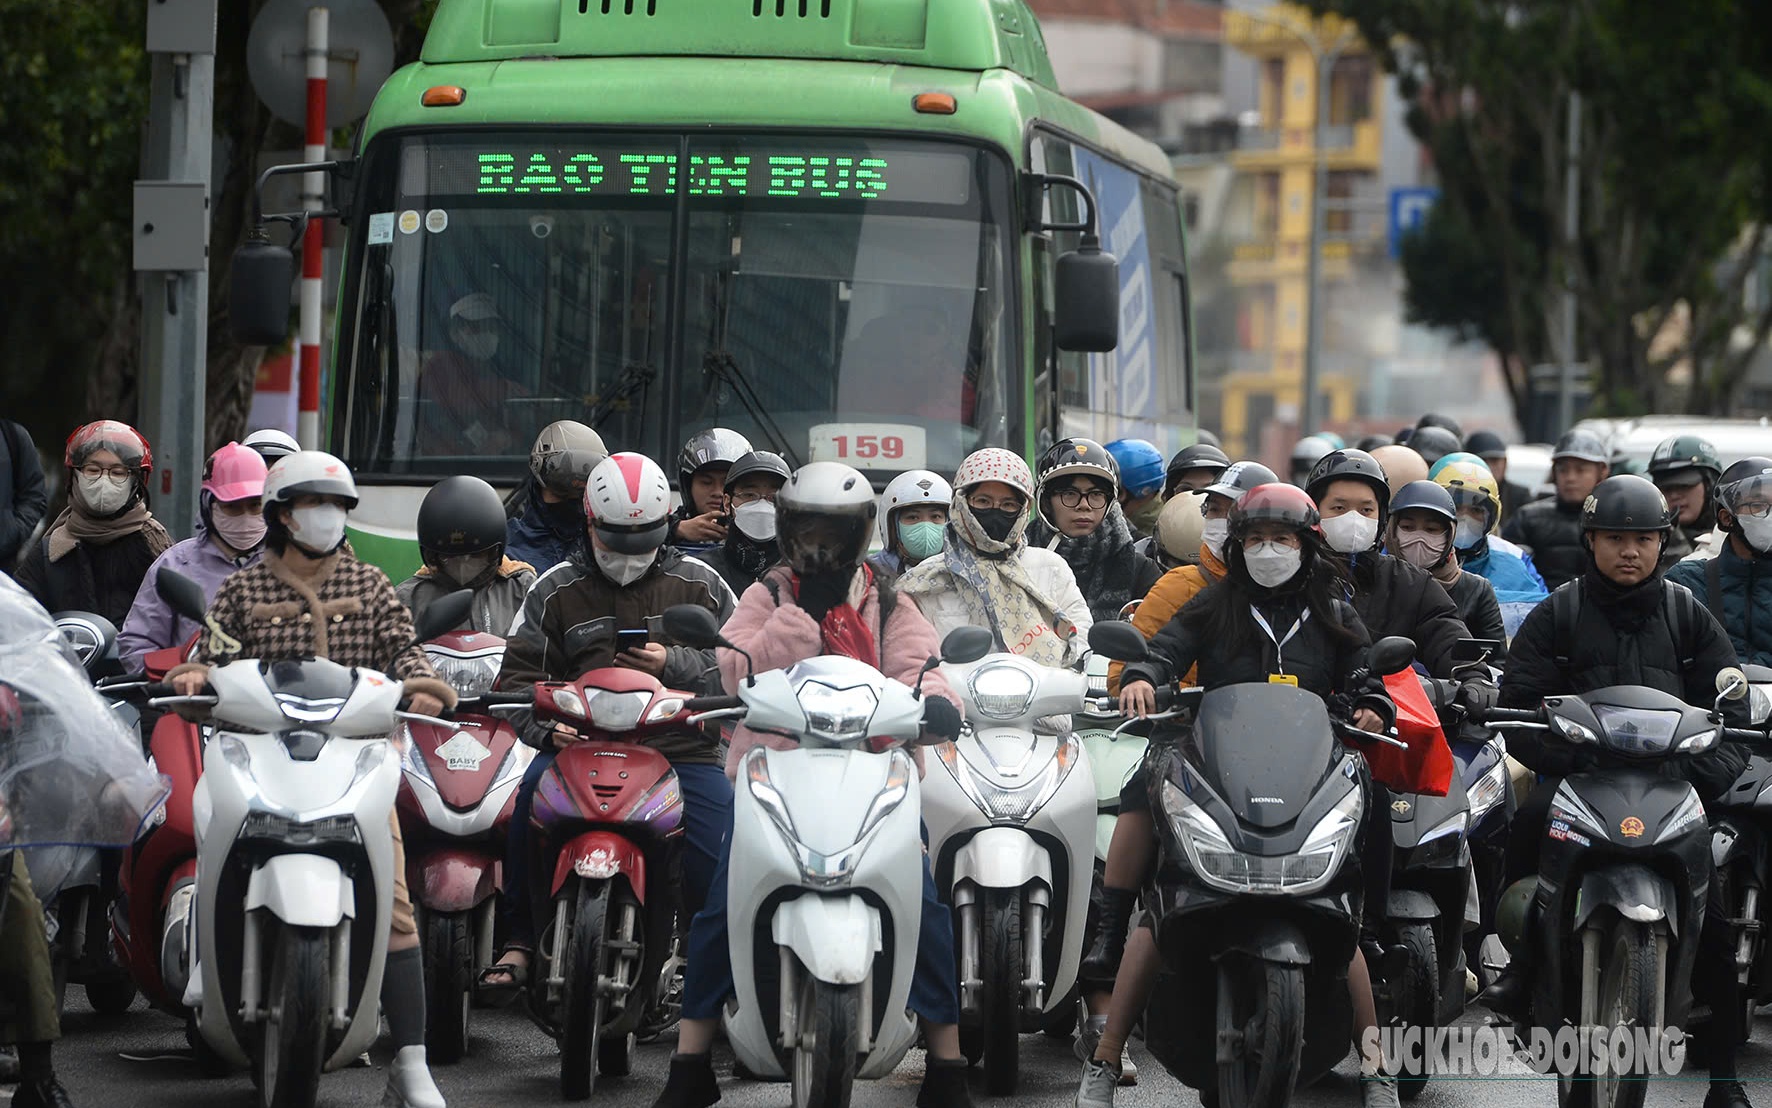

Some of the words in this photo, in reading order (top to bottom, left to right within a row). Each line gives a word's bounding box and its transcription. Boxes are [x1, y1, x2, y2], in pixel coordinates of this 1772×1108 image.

[477, 154, 604, 193] BAO
[768, 156, 888, 198] BUS
[832, 435, 904, 459] 159
